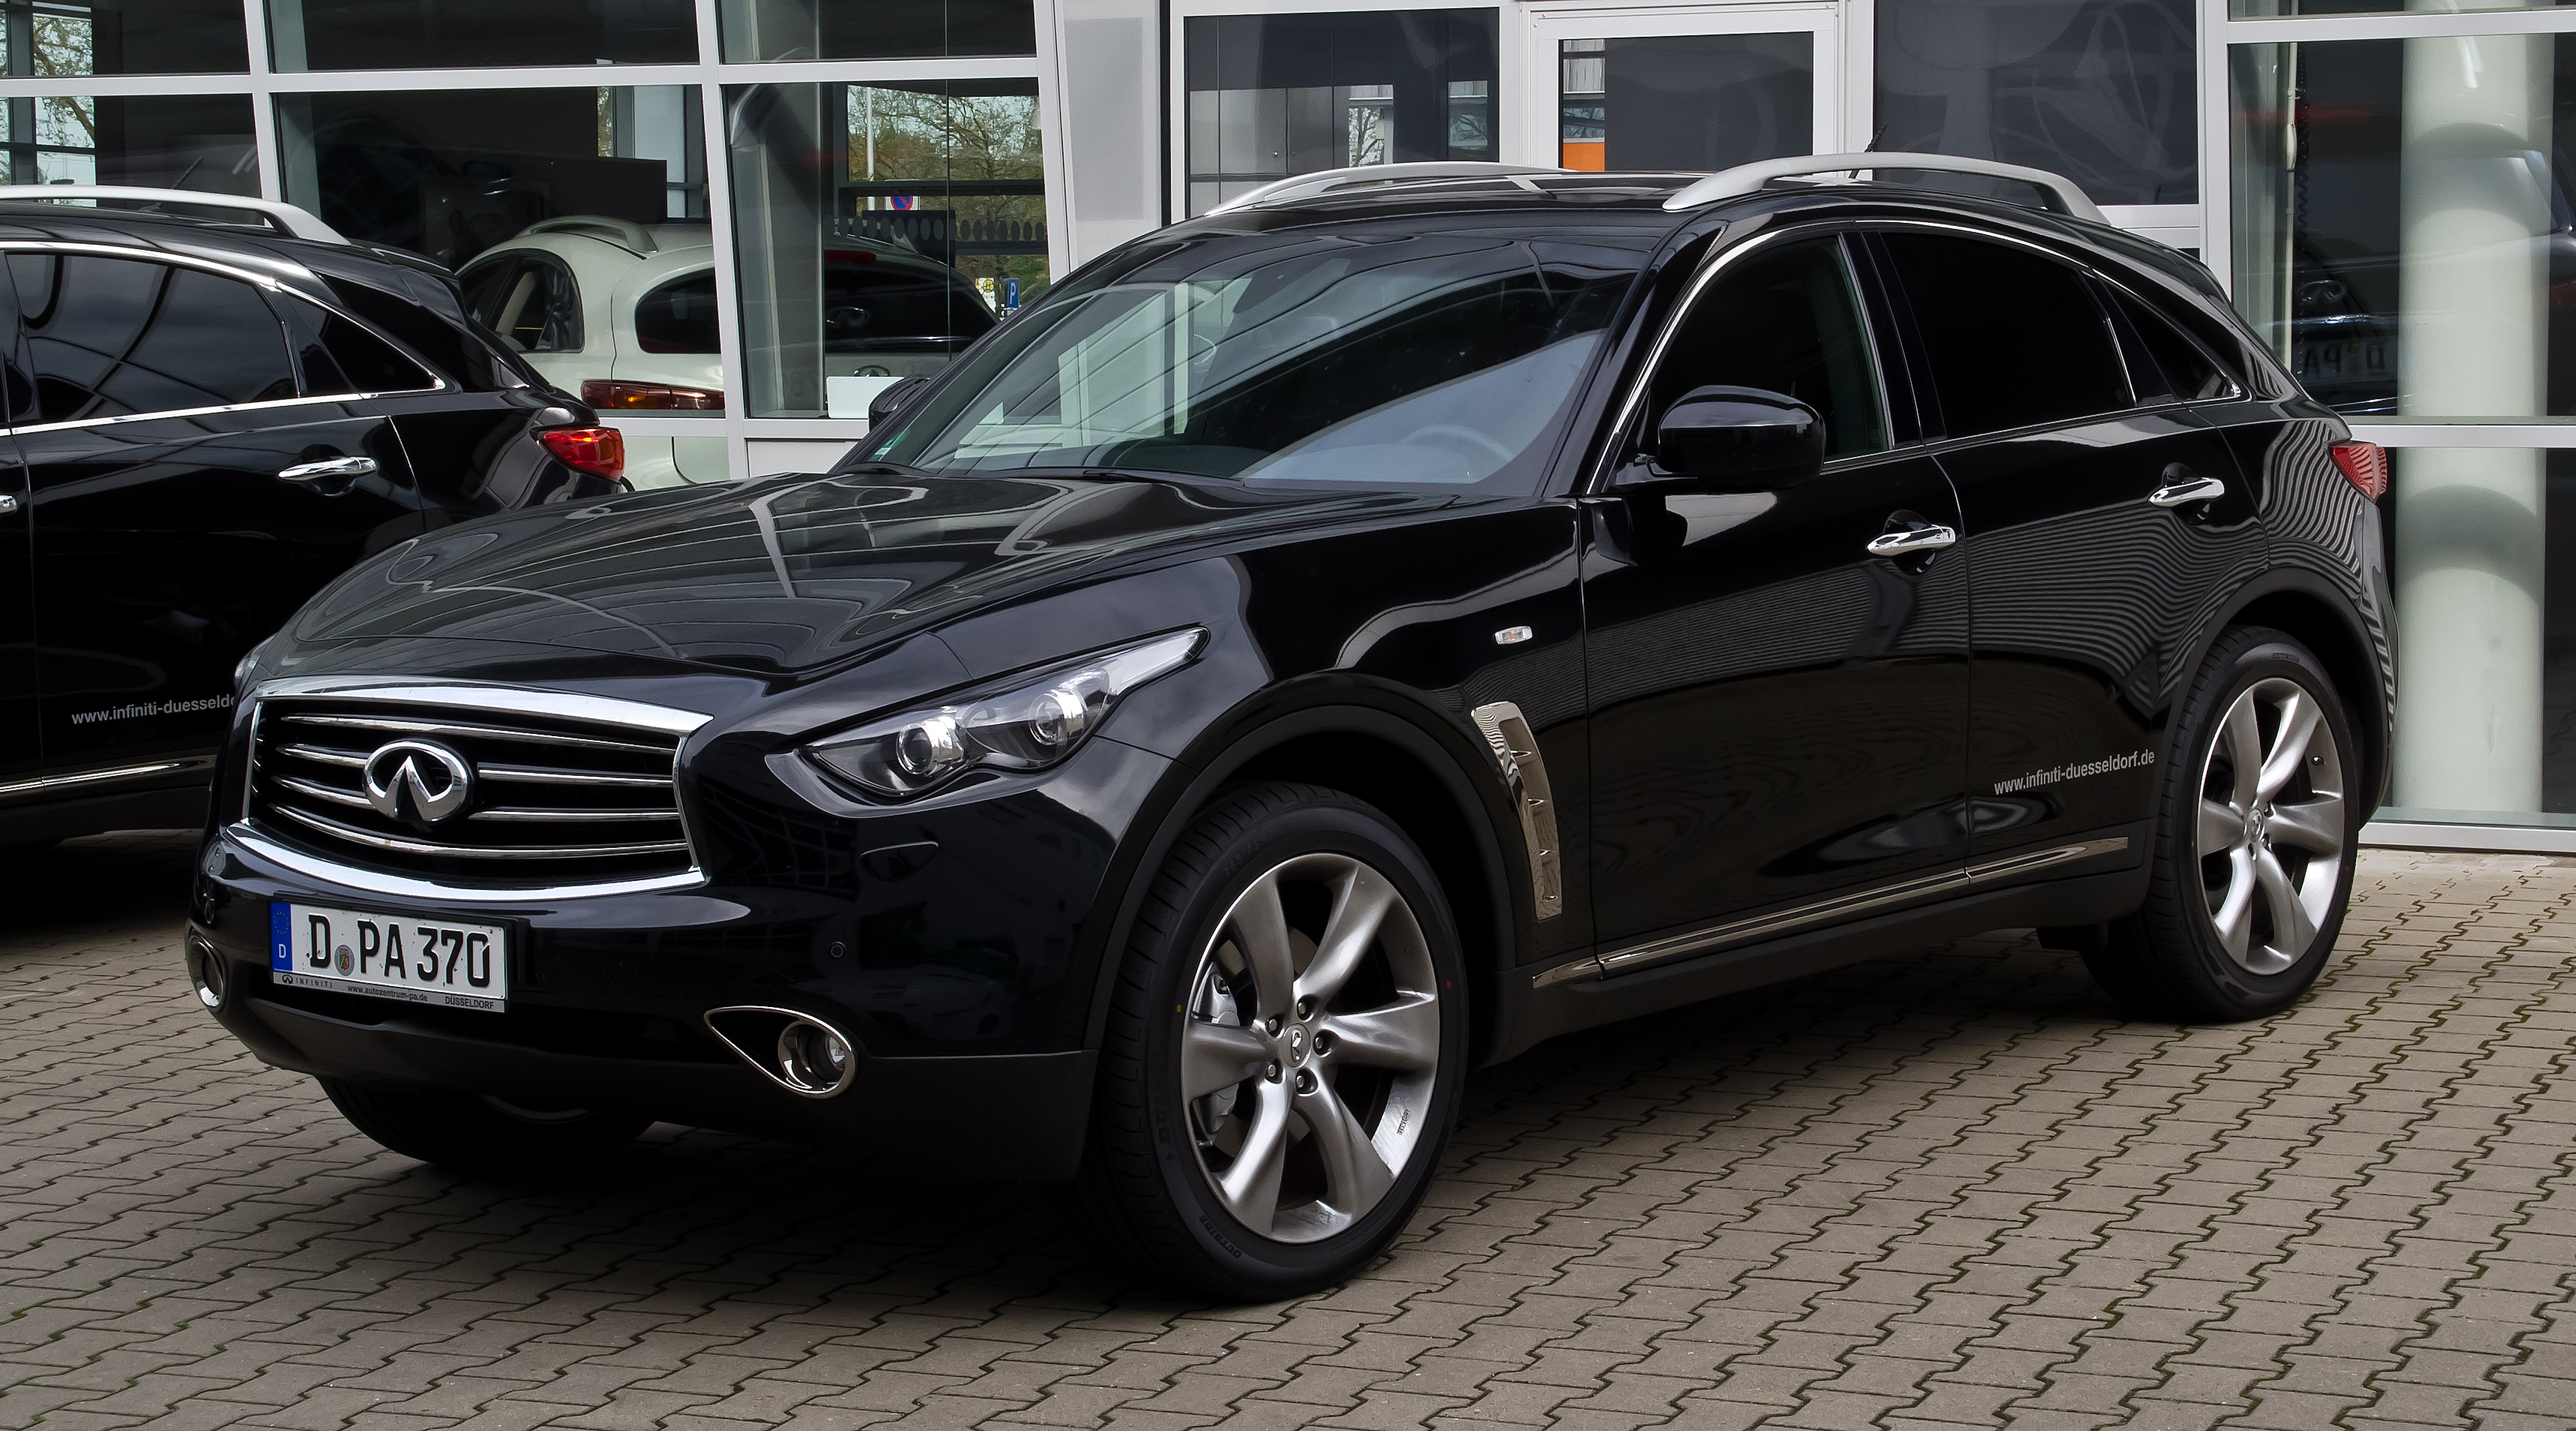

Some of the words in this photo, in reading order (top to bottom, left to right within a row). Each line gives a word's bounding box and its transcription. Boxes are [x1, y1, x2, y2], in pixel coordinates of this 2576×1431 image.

[1010, 282, 1016, 305] P
[1994, 748, 2156, 795] www.infiniti-duesseldorf.de
[278, 943, 287, 959] D
[308, 912, 331, 968] D
[357, 918, 407, 979] PA
[417, 926, 490, 988] 370
[296, 977, 333, 989] INFINITI
[348, 985, 428, 1002] www.autozentrum-pa.de
[445, 995, 495, 1009] DÜSSELDORF
